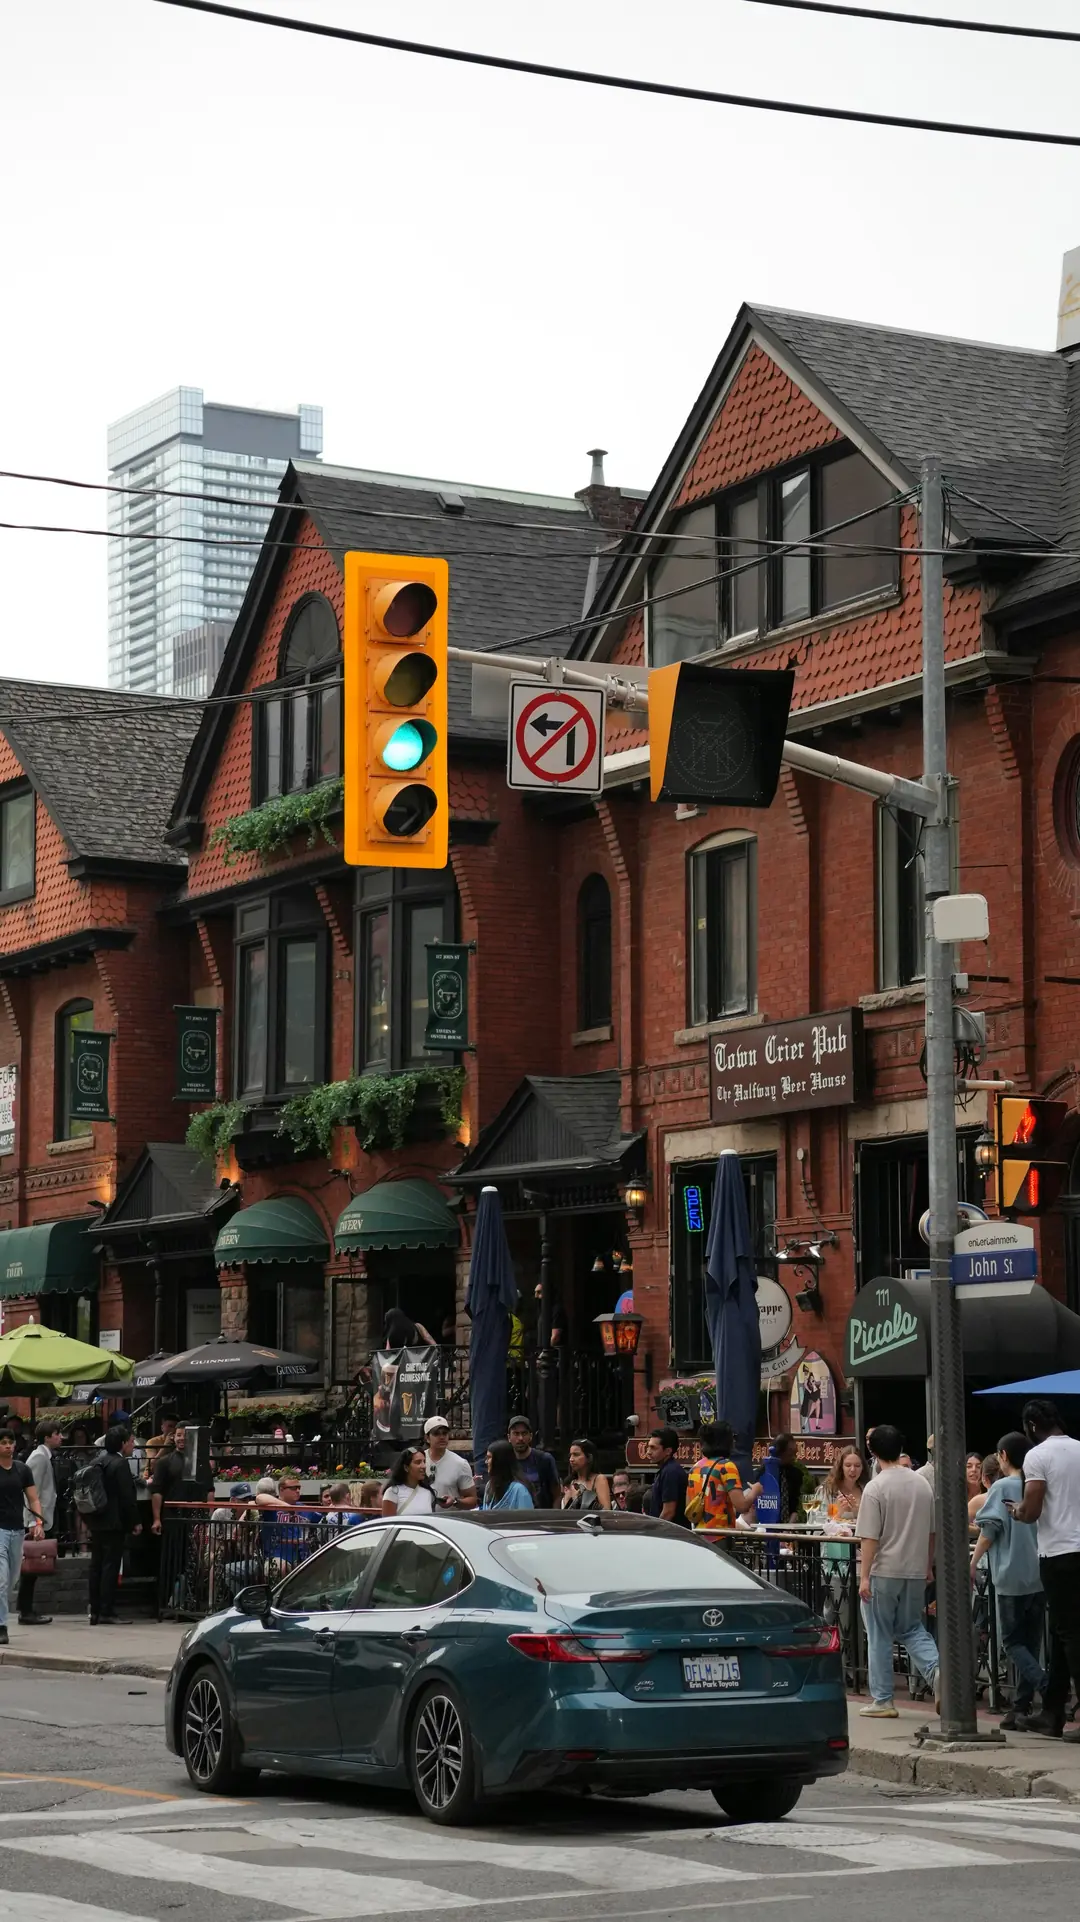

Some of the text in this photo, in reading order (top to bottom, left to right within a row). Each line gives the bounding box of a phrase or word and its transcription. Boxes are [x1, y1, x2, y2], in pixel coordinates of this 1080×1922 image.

[714, 1023, 848, 1073] Town Crier Pub
[716, 1072, 847, 1108] The Halfway Beer House
[687, 1188, 702, 1230] OPEN
[967, 1234, 1018, 1248] entertainment
[969, 1257, 1013, 1278] John St
[876, 1288, 890, 1307] 111
[759, 1304, 783, 1316] rappe
[850, 1302, 918, 1366] Piccolo
[190, 1357, 241, 1365] GUINNESS
[772, 1357, 789, 1371] Crier
[276, 1365, 307, 1375] GUINNESS
[796, 1441, 822, 1461] Beer
[757, 1499, 778, 1510] PERONI
[689, 1681, 702, 1689] Erin
[718, 1681, 739, 1689] Toyota
